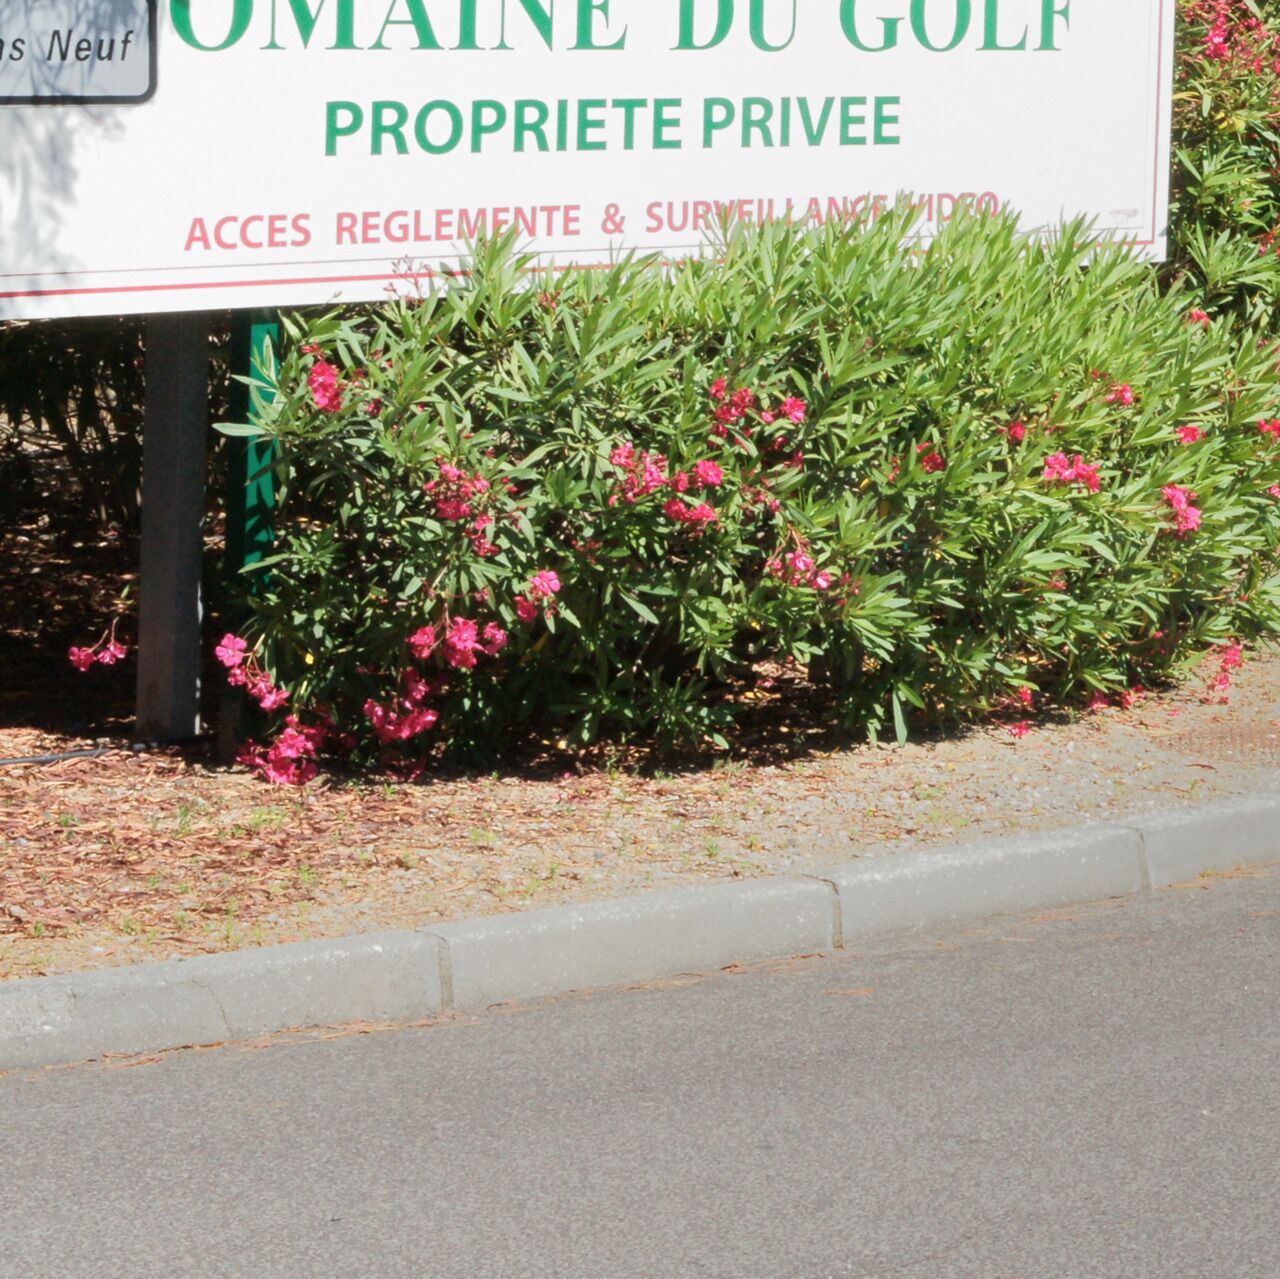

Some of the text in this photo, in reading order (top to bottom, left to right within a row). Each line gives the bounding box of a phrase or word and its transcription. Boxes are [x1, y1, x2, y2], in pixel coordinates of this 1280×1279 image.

[46, 29, 134, 62] Neuf
[324, 96, 901, 157] PROPRIETE PRIVEE
[183, 212, 313, 252] ACCES
[335, 204, 582, 246] REGLEMENTE
[600, 202, 627, 235] &
